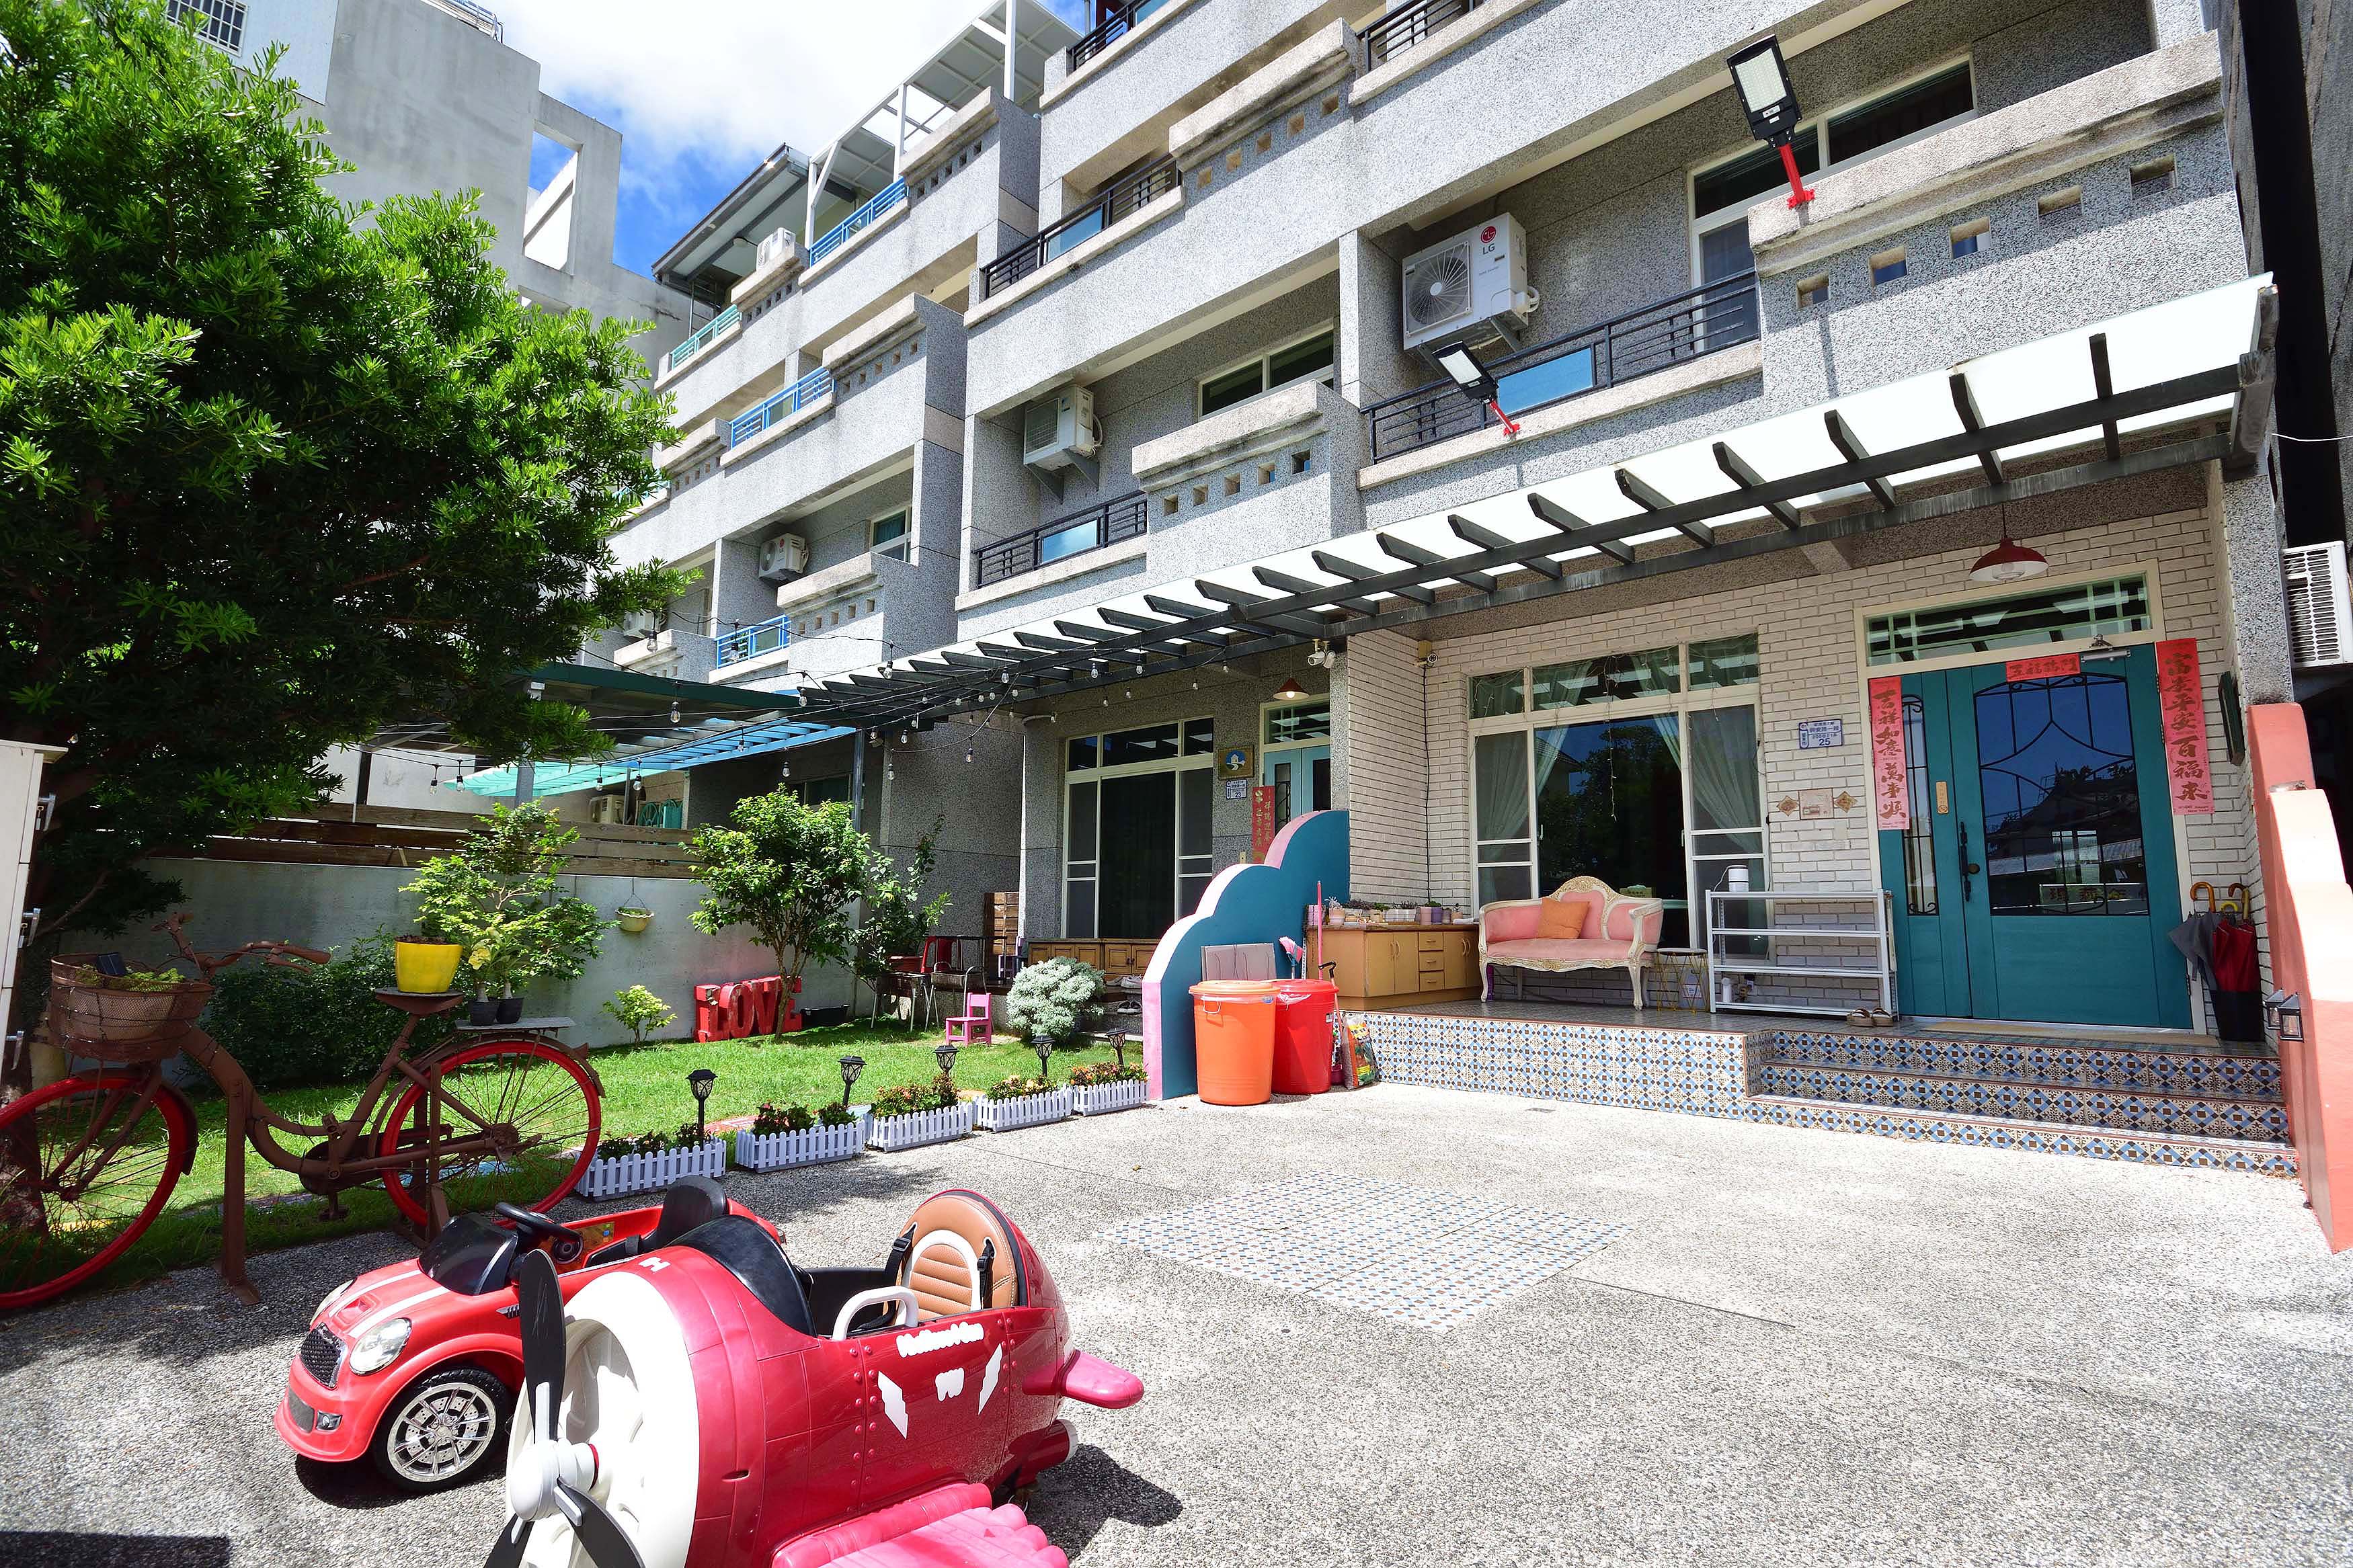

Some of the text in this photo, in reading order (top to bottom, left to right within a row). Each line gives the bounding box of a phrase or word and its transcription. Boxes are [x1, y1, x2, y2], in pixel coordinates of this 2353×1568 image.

[1483, 243, 1494, 255] LG
[1819, 738, 1831, 746] 25
[694, 975, 802, 1043] LOVE
